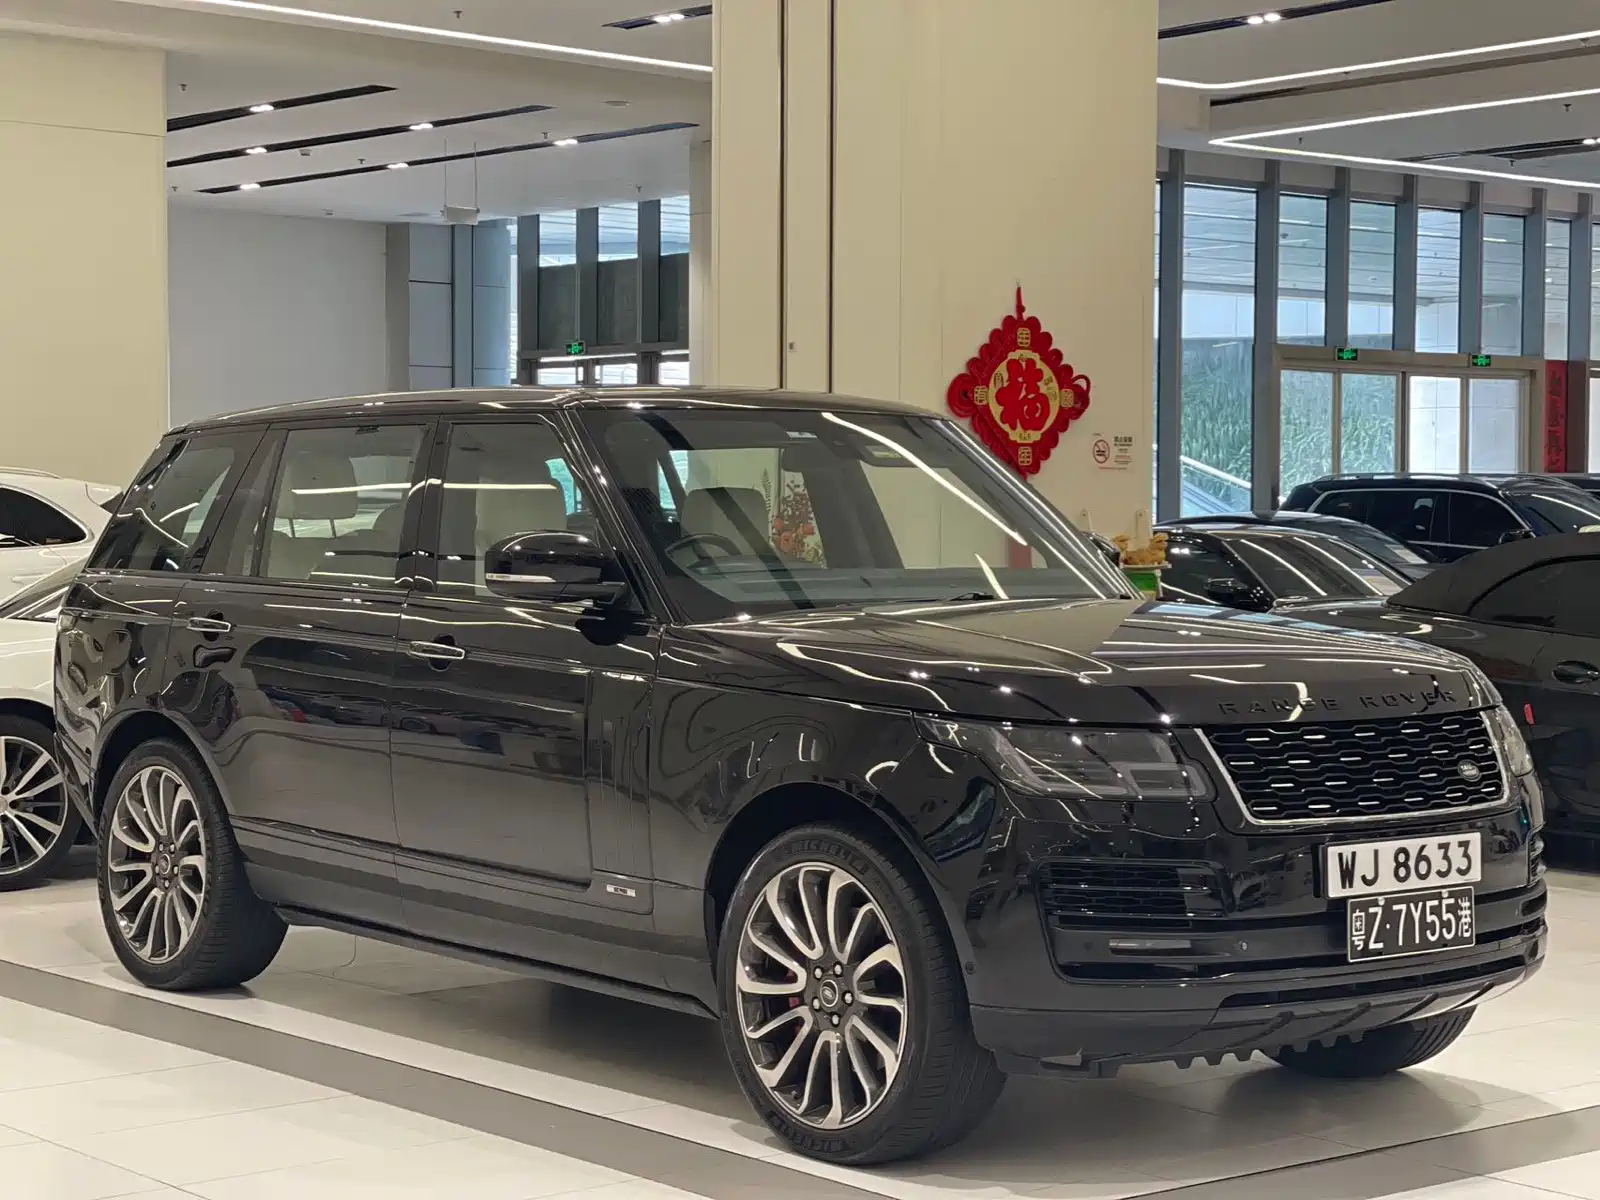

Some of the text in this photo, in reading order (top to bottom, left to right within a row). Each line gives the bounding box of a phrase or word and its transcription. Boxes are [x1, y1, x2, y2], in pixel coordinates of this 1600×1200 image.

[995, 357, 1050, 432] 福
[1219, 690, 1457, 715] RANGE ROVER
[1337, 839, 1473, 890] WJ 8633
